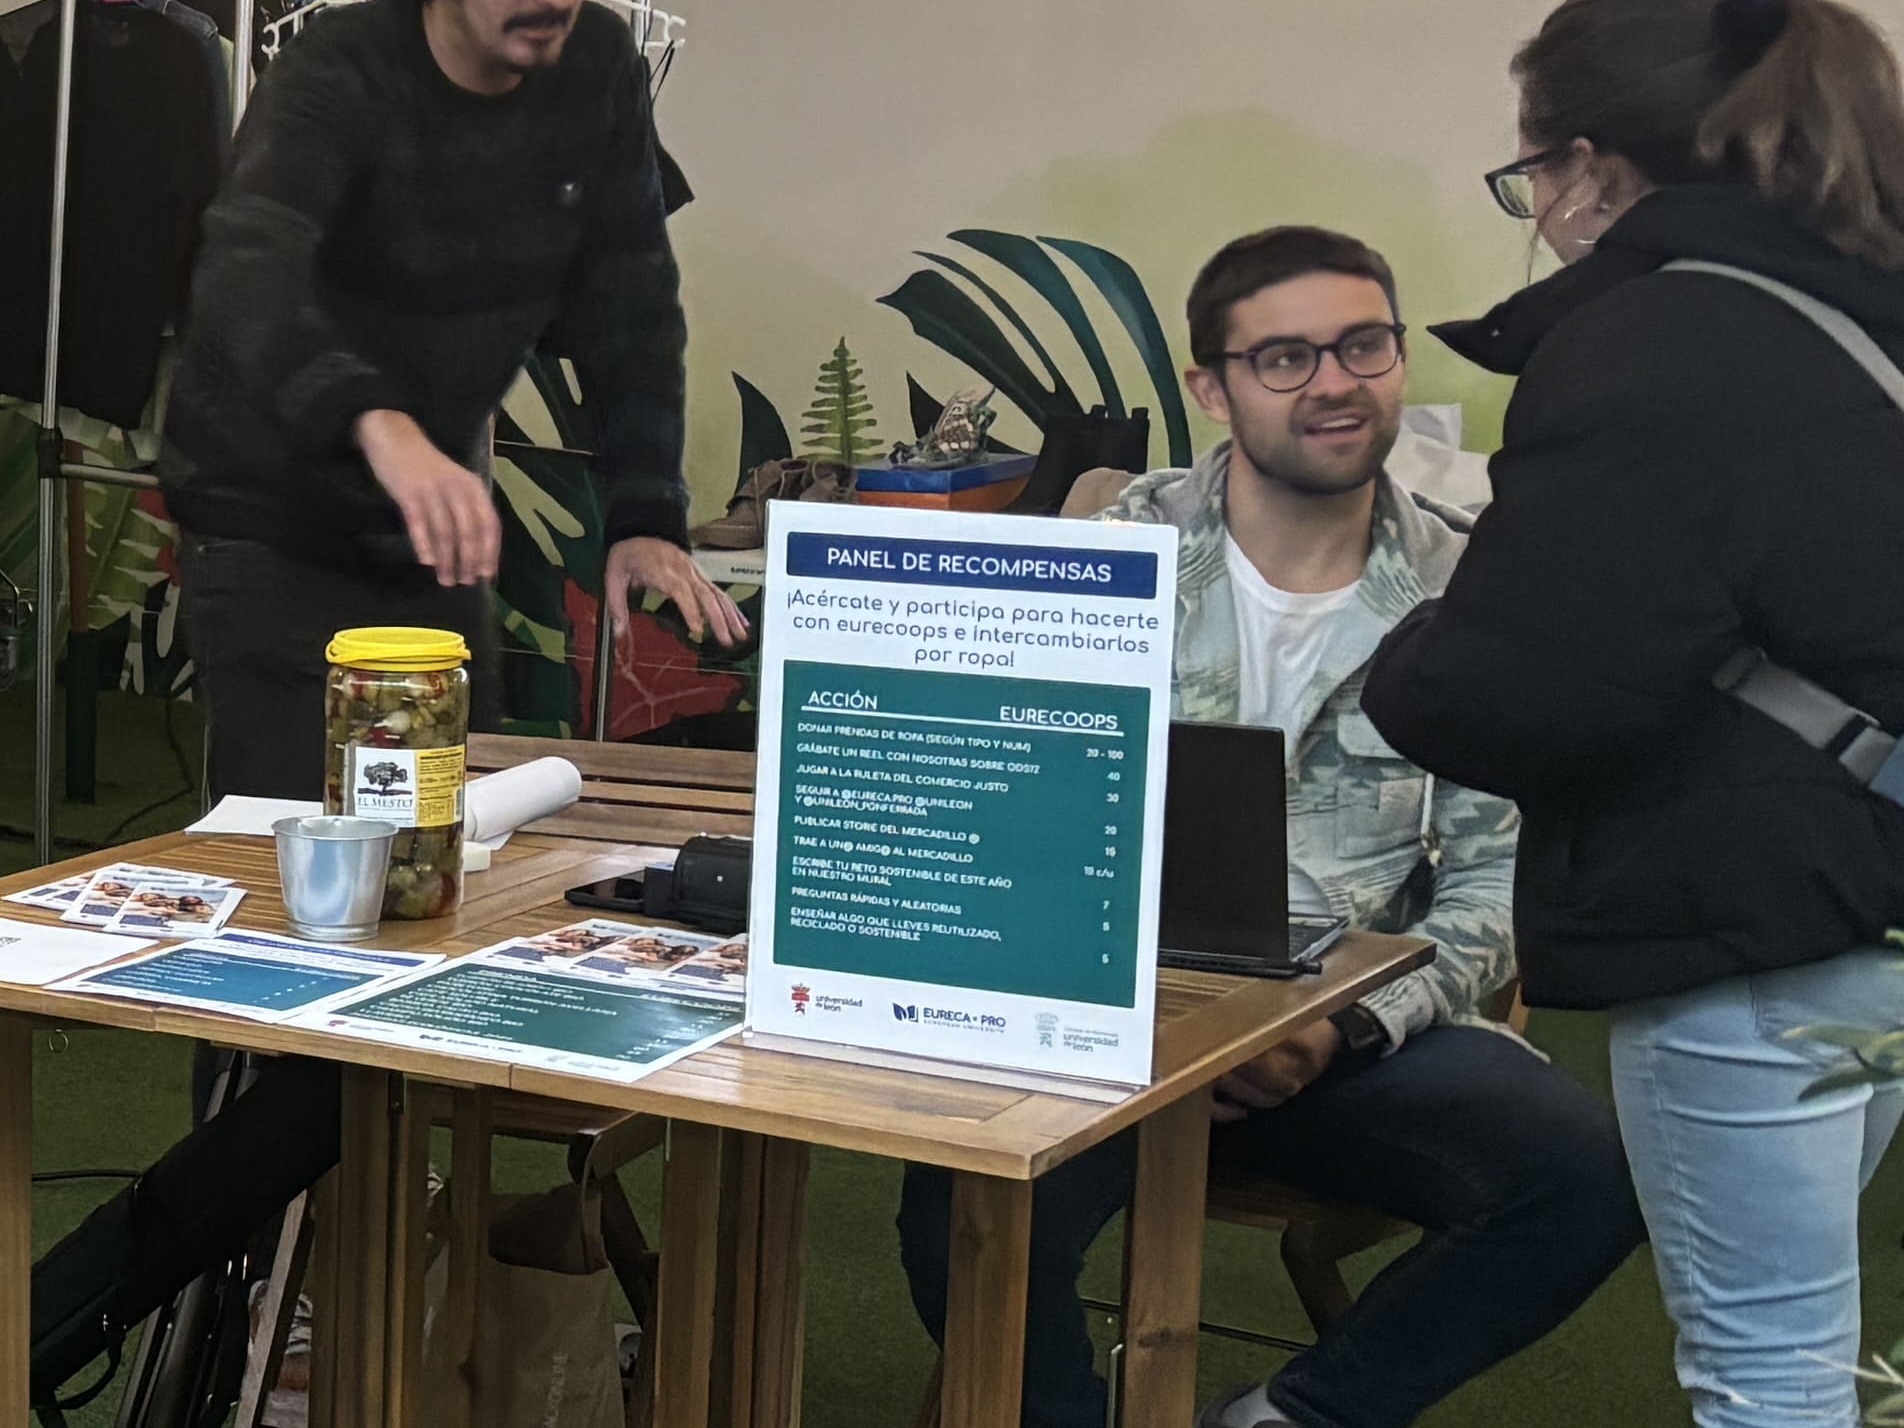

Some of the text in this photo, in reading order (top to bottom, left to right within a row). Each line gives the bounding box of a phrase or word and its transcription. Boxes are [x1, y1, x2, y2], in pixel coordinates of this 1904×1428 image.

[827, 548, 1112, 582] PANEL DE RECOMPENSAS
[788, 588, 1158, 630] ¡Acércate y participa para hacerte
[793, 616, 1149, 654] con eurecoops e intercambiarlos
[914, 648, 1014, 669] por ropa!
[808, 690, 878, 710] ACCIÓN
[1000, 706, 1118, 730] EURECOOPS
[882, 730, 894, 740] DE
[926, 733, 964, 747] (SEGÚN
[968, 738, 990, 748] TIPO
[994, 740, 1000, 749] Y
[842, 748, 857, 758] UN
[886, 752, 910, 762] CON
[1108, 750, 1124, 760] 100
[796, 764, 828, 775] JUGAR
[830, 768, 837, 776] A
[840, 768, 852, 777] LA
[894, 774, 912, 784] DEL
[915, 775, 971, 789] COMERCIO
[974, 780, 1008, 792] JUSTO
[832, 788, 840, 797] A
[880, 824, 899, 834] DEL
[902, 826, 966, 842] MERCADILLO
[794, 836, 817, 847] TRAE
[820, 839, 826, 847] A
[893, 848, 904, 856] AL
[908, 849, 974, 863] MERCADILLO
[836, 860, 848, 870] TU
[944, 873, 958, 884] DE
[960, 875, 986, 886] ESTE
[988, 876, 1012, 888] AÑO
[892, 899, 899, 908] Y
[902, 900, 962, 914] ALEATORIAS
[838, 914, 864, 924] ALGO
[867, 916, 890, 926] QUE
[848, 924, 856, 933] O
[923, 1008, 1006, 1028] EURECA PRO
